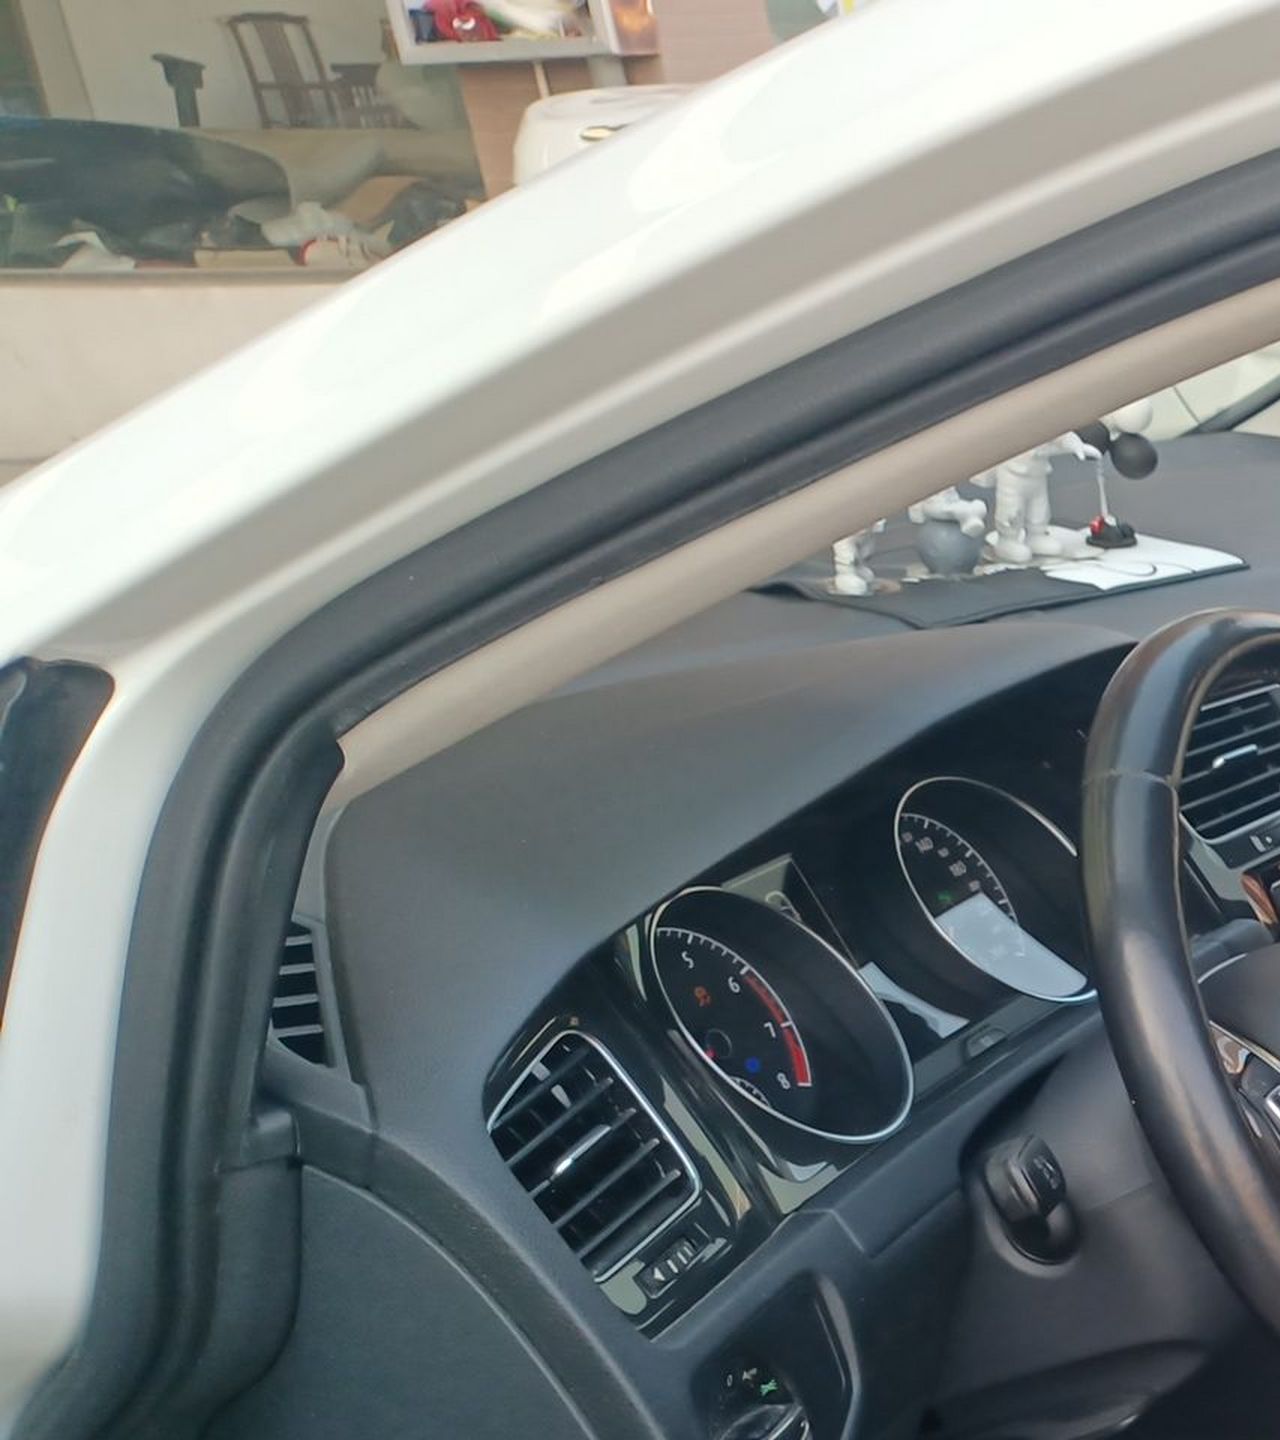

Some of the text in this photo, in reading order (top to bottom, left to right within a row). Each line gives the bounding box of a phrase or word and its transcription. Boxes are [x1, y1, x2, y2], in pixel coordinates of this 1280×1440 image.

[682, 951, 695, 969] 5
[728, 976, 741, 993] 6
[764, 1022, 776, 1038] 7
[776, 1072, 791, 1090] 8
